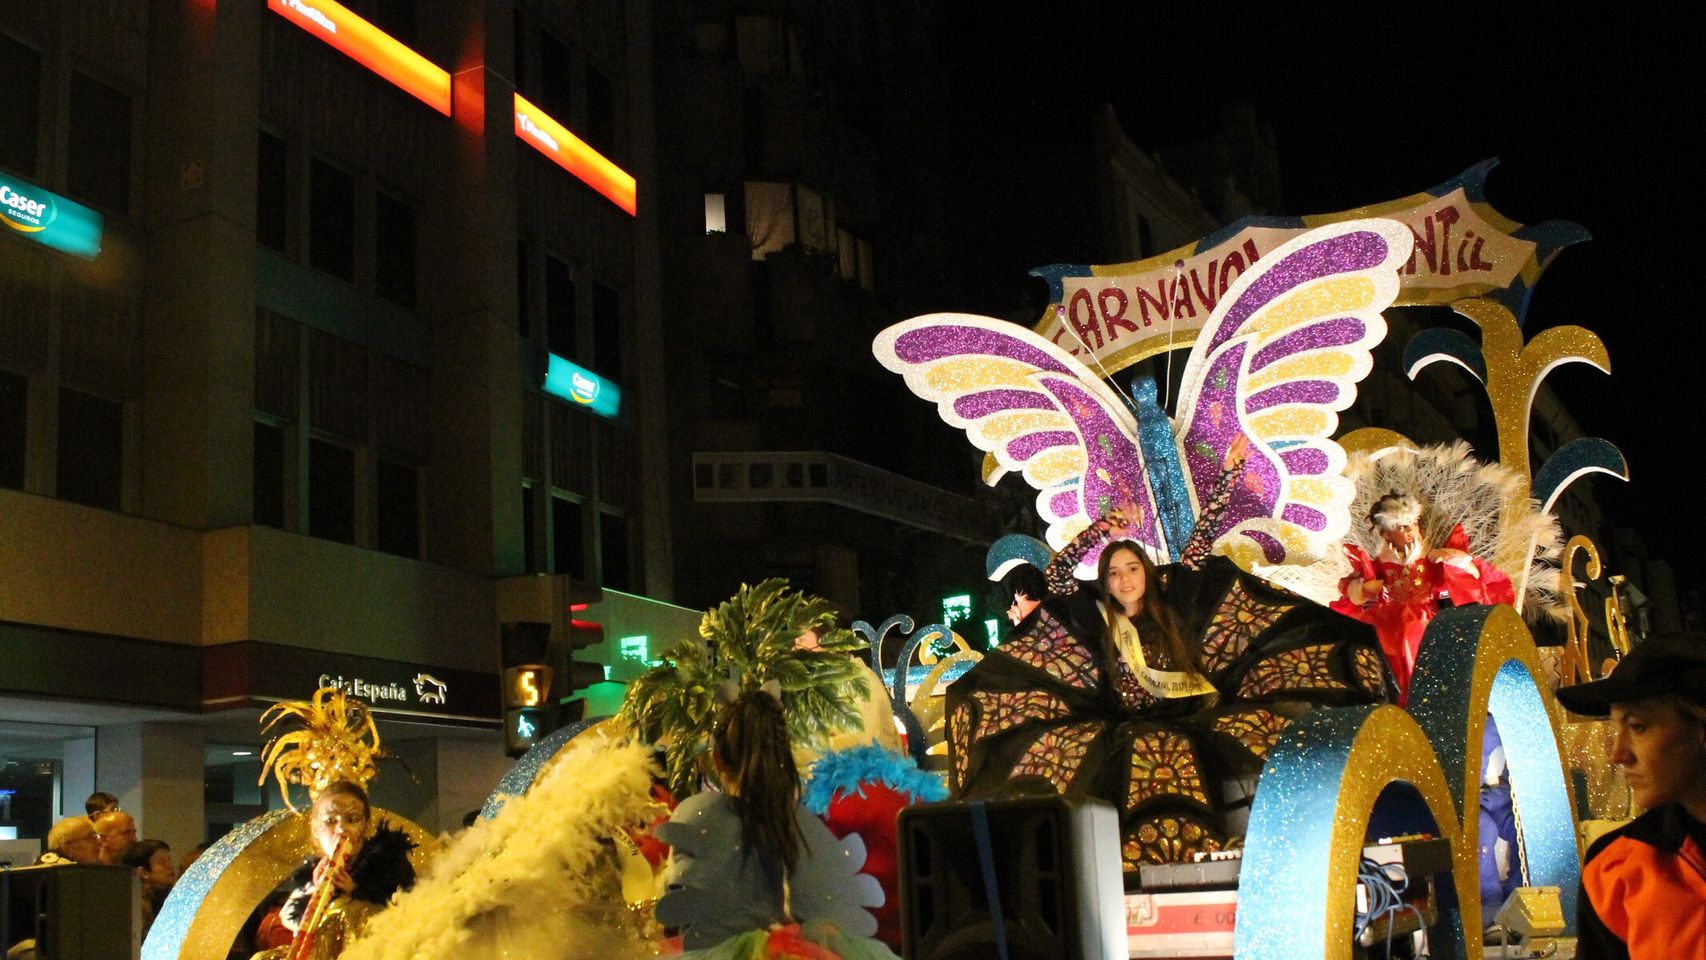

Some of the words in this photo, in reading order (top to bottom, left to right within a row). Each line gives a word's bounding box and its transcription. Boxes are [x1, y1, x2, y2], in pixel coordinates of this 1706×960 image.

[0, 185, 46, 217] Caser
[8, 208, 40, 225] SEGUROS
[1051, 238, 1260, 356] CARNAVA
[354, 678, 408, 703] España
[521, 671, 539, 706] 5
